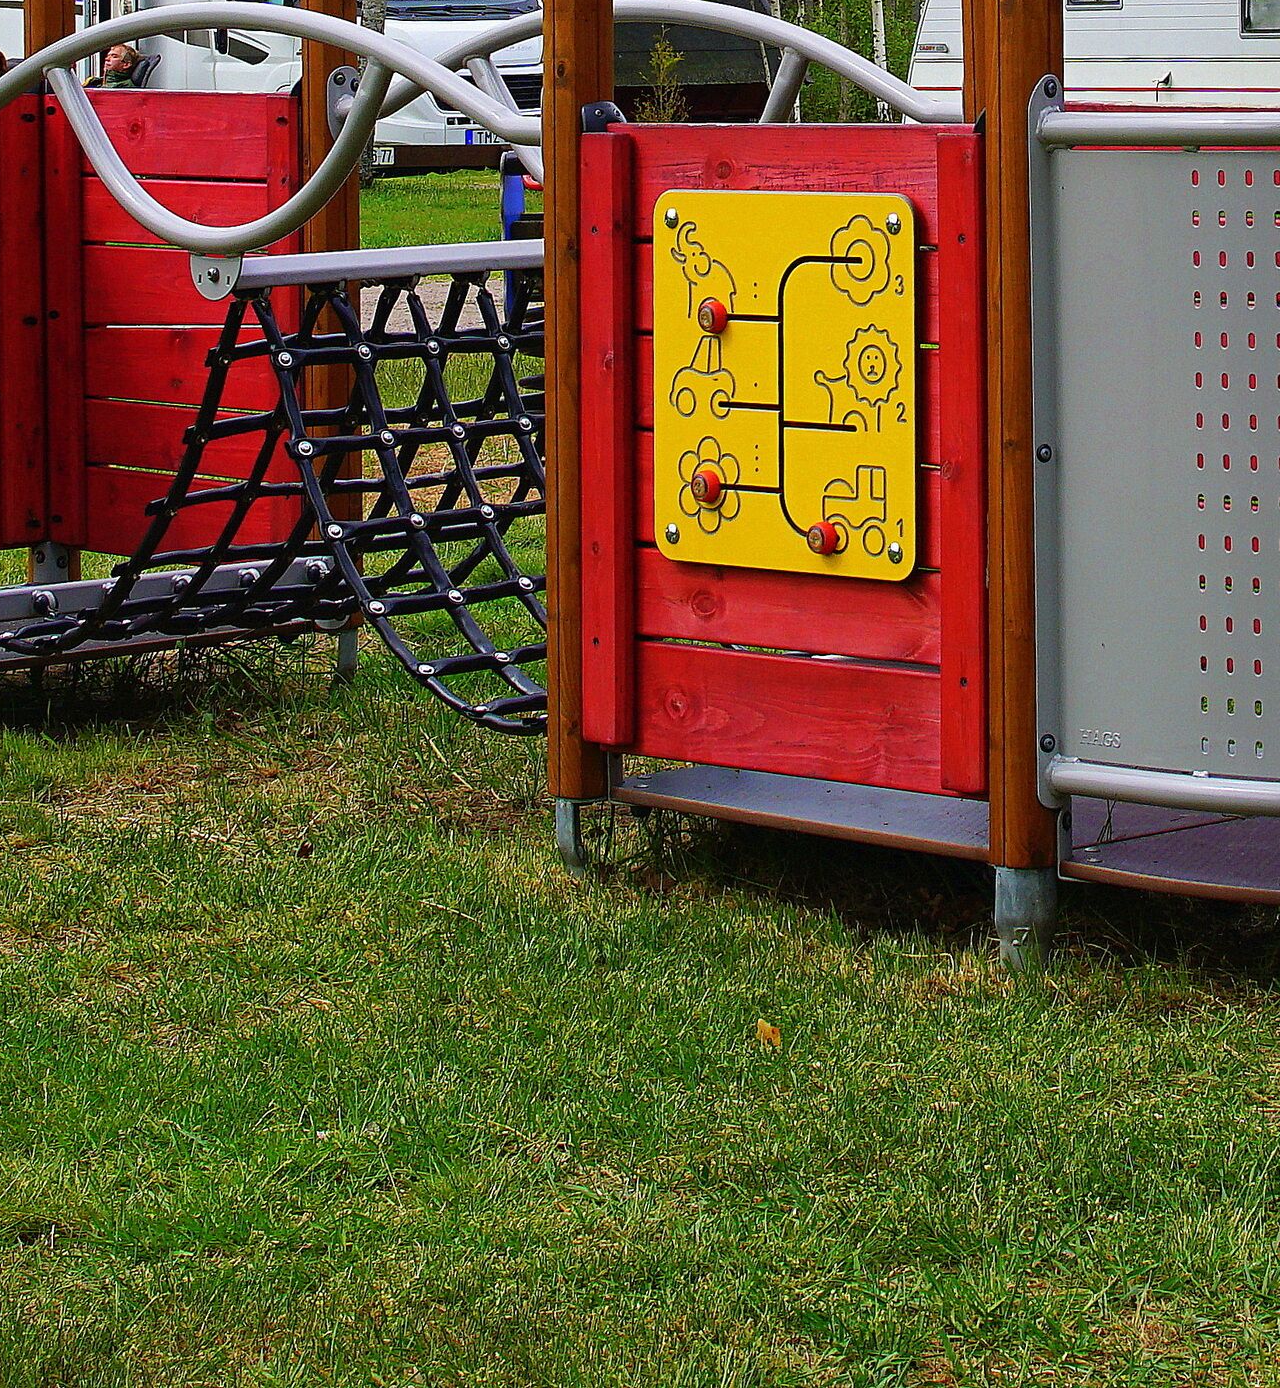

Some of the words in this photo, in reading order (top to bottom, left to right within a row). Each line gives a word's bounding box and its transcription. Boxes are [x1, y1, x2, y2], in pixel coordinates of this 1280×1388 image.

[894, 274, 905, 296] 3
[896, 401, 907, 423] 2
[896, 518, 904, 538] 1
[1079, 728, 1122, 749] HAGS
